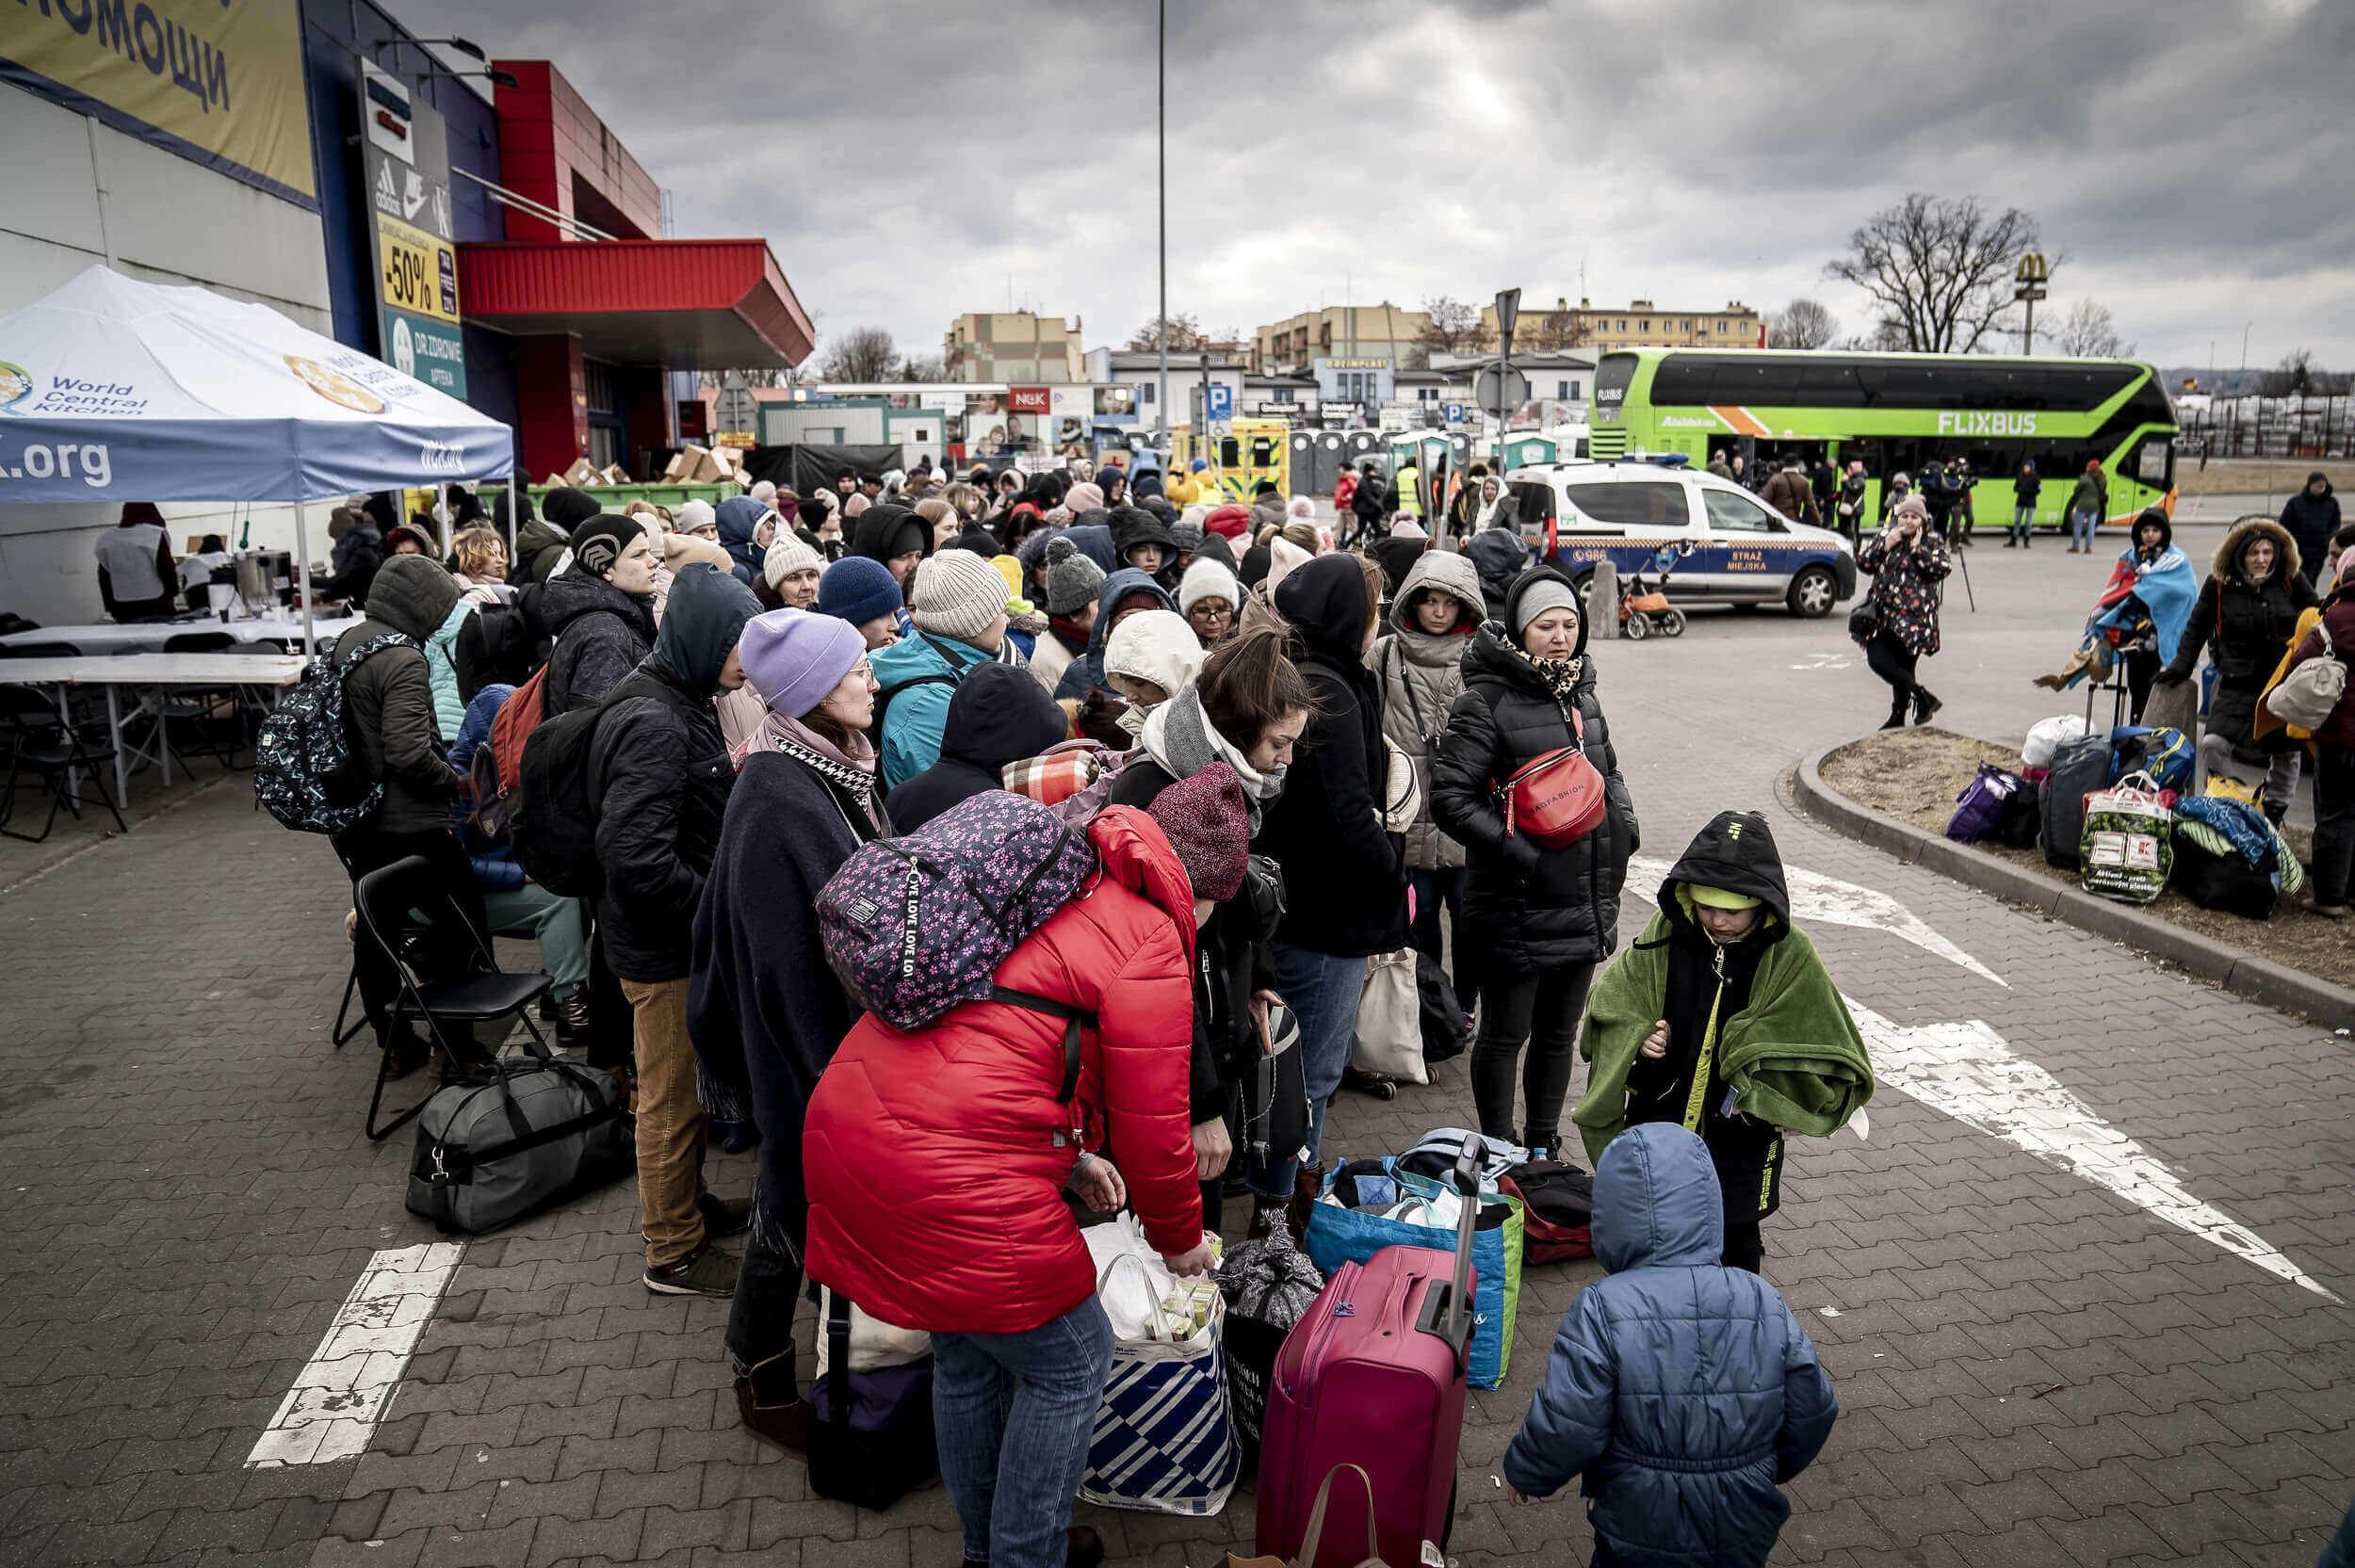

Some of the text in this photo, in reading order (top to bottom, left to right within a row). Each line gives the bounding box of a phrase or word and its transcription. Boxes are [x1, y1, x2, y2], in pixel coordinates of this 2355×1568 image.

[16, 0, 230, 115] МОЩИ
[385, 246, 431, 311] -50%
[53, 376, 133, 396] World
[33, 402, 144, 415] Kitchen
[44, 391, 148, 408] Central
[1210, 387, 1232, 412] P
[1449, 405, 1459, 419] P
[1585, 549, 1607, 562] 986
[1731, 551, 1762, 561] STRAŻ
[1727, 561, 1767, 571] MIEJSKA
[907, 899, 918, 926] LOVE
[904, 930, 917, 956] LOVE
